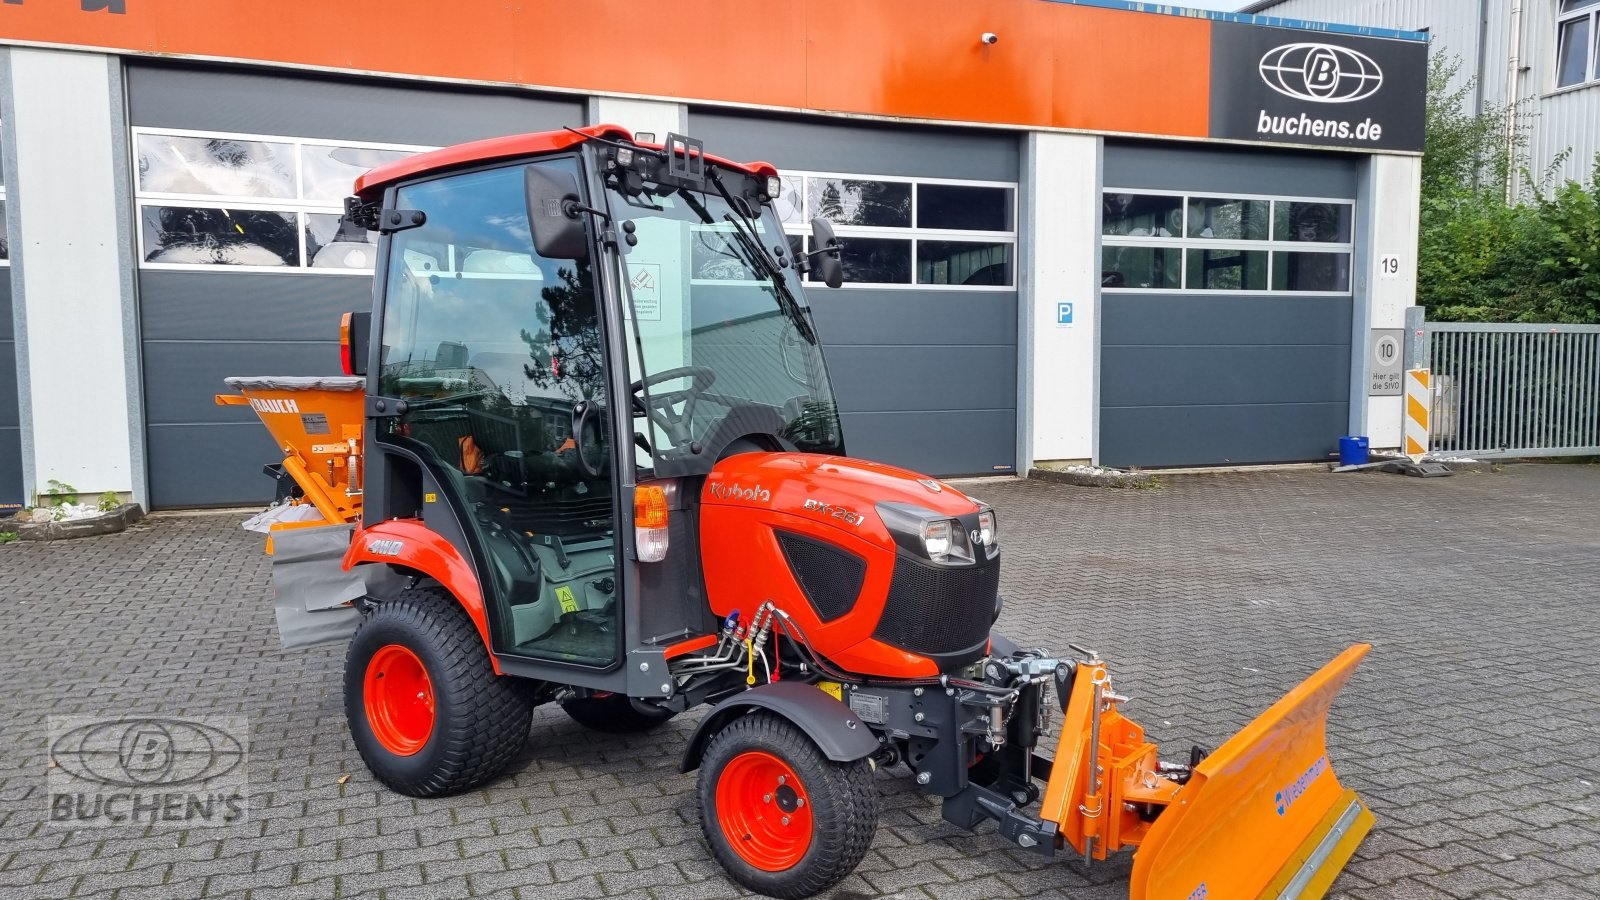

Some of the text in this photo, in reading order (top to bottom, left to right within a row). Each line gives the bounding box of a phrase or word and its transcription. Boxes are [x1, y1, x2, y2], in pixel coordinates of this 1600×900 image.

[1257, 110, 1382, 140] buchens.de
[1382, 258, 1398, 274] 19
[1060, 304, 1071, 322] P
[1381, 343, 1393, 358] 10
[1372, 372, 1400, 382] Hier gilt
[1372, 382, 1400, 390] die StVO
[710, 481, 771, 502] Kubota
[803, 499, 865, 527] BX-261
[368, 540, 404, 556] 4WD
